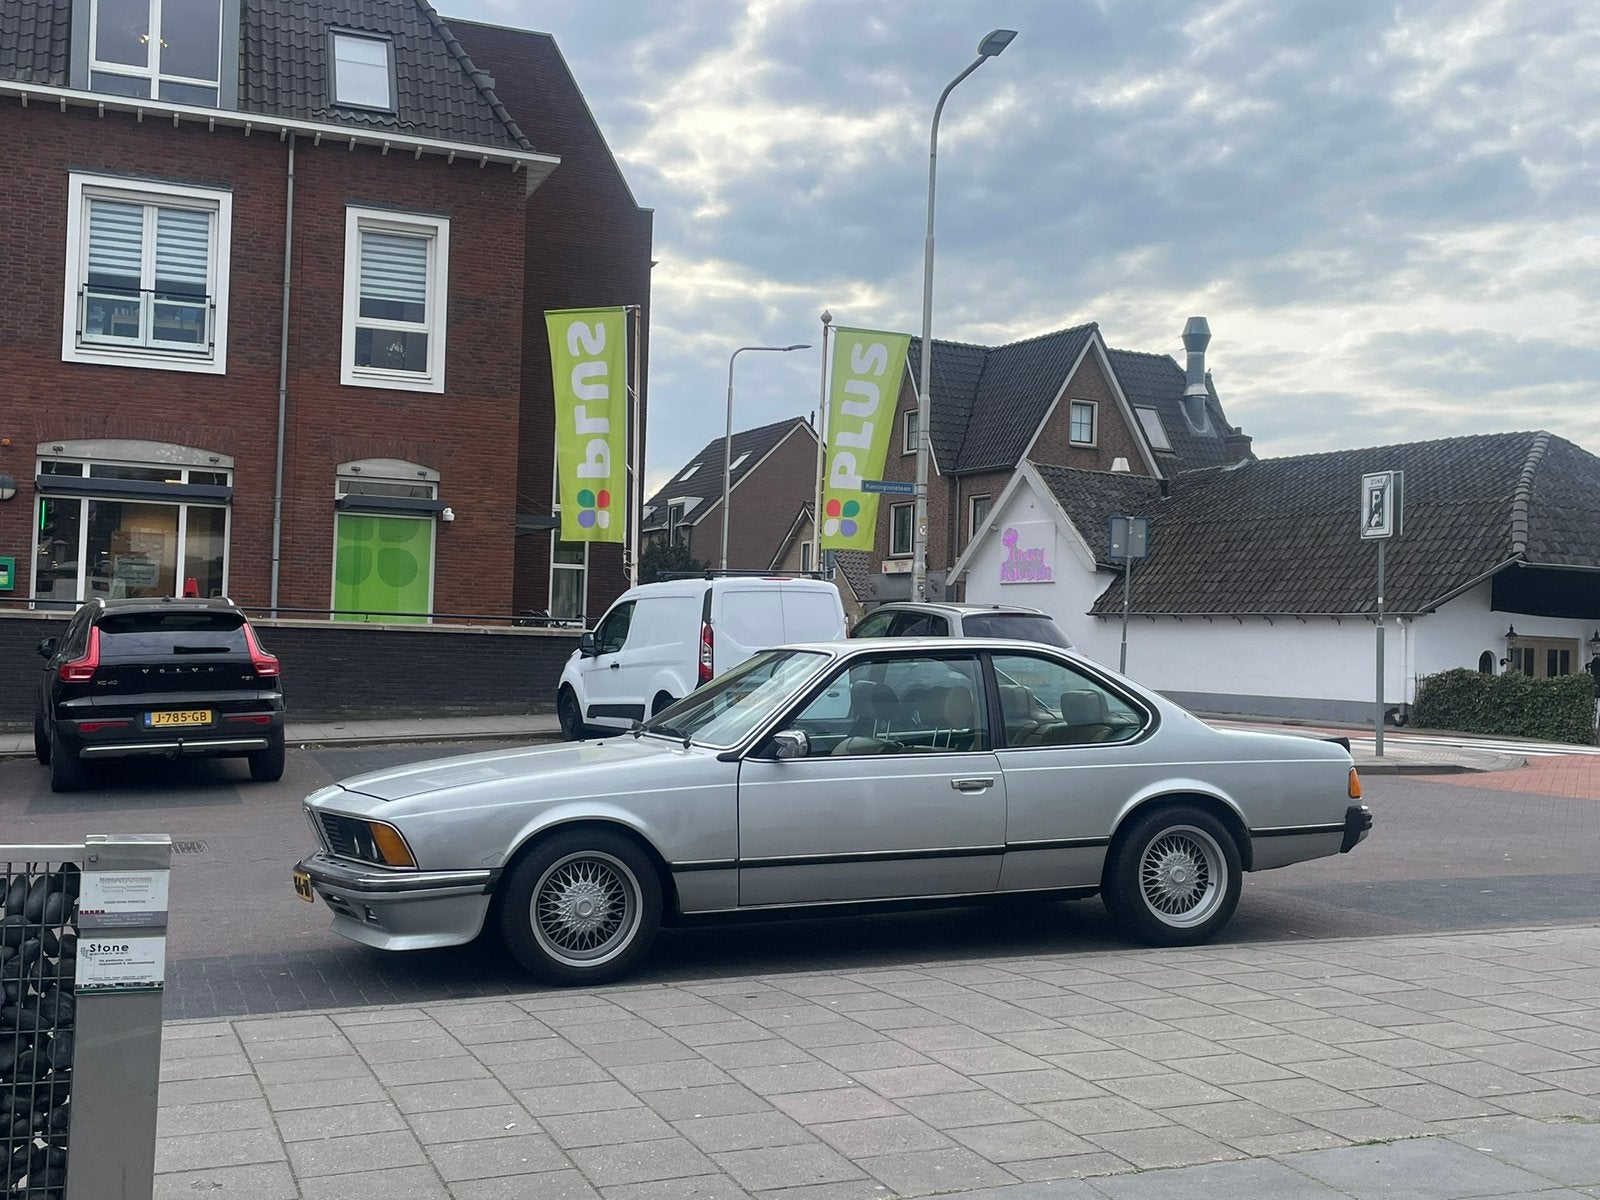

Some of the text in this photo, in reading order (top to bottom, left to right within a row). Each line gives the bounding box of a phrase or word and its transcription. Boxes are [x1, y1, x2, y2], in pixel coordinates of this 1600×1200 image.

[829, 342, 889, 490] PLUS
[142, 666, 214, 674] VOLVO
[155, 711, 207, 724] J-785-GB
[89, 943, 129, 953] Stone
